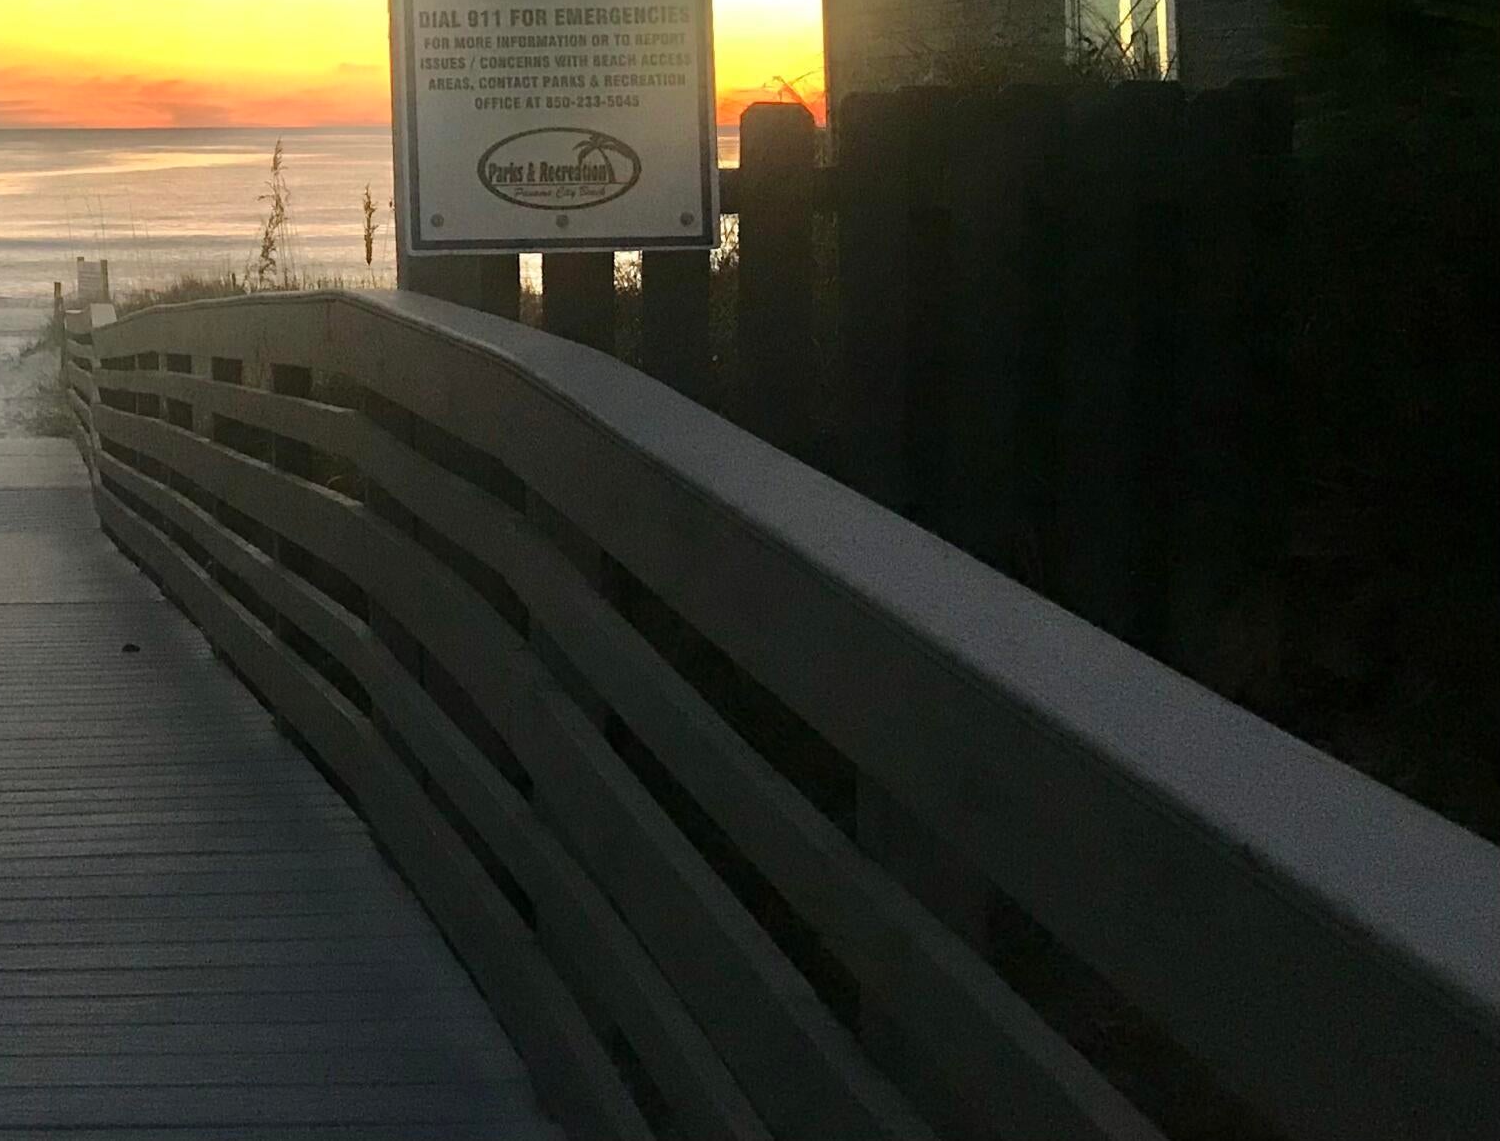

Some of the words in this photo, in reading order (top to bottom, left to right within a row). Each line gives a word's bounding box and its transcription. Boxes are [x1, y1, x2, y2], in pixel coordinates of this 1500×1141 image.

[418, 10, 461, 28] DIAL
[466, 9, 501, 27] 911
[510, 8, 547, 26] FOR
[554, 5, 691, 26] EMERGENCIES
[424, 37, 450, 50] FOR
[454, 36, 492, 50] MORE
[496, 33, 587, 48] INFORMATION
[591, 33, 610, 47] OR
[613, 33, 631, 46] TO
[634, 31, 686, 46] REPORT
[420, 57, 467, 70] ISSUES
[479, 55, 550, 69] CONCERNS
[555, 54, 588, 68] WITH
[592, 53, 638, 67] BEACH
[641, 51, 692, 66] ACCESS
[428, 77, 475, 91] AREAS,
[479, 76, 538, 90] CONTACT
[542, 75, 586, 89] PARKS
[589, 75, 600, 88] &
[603, 72, 686, 87] RECREATION
[474, 96, 521, 110] OFFICE
[524, 96, 541, 109] AT
[489, 162, 524, 183] Parks
[526, 162, 536, 182] &
[539, 161, 607, 182] Recreation
